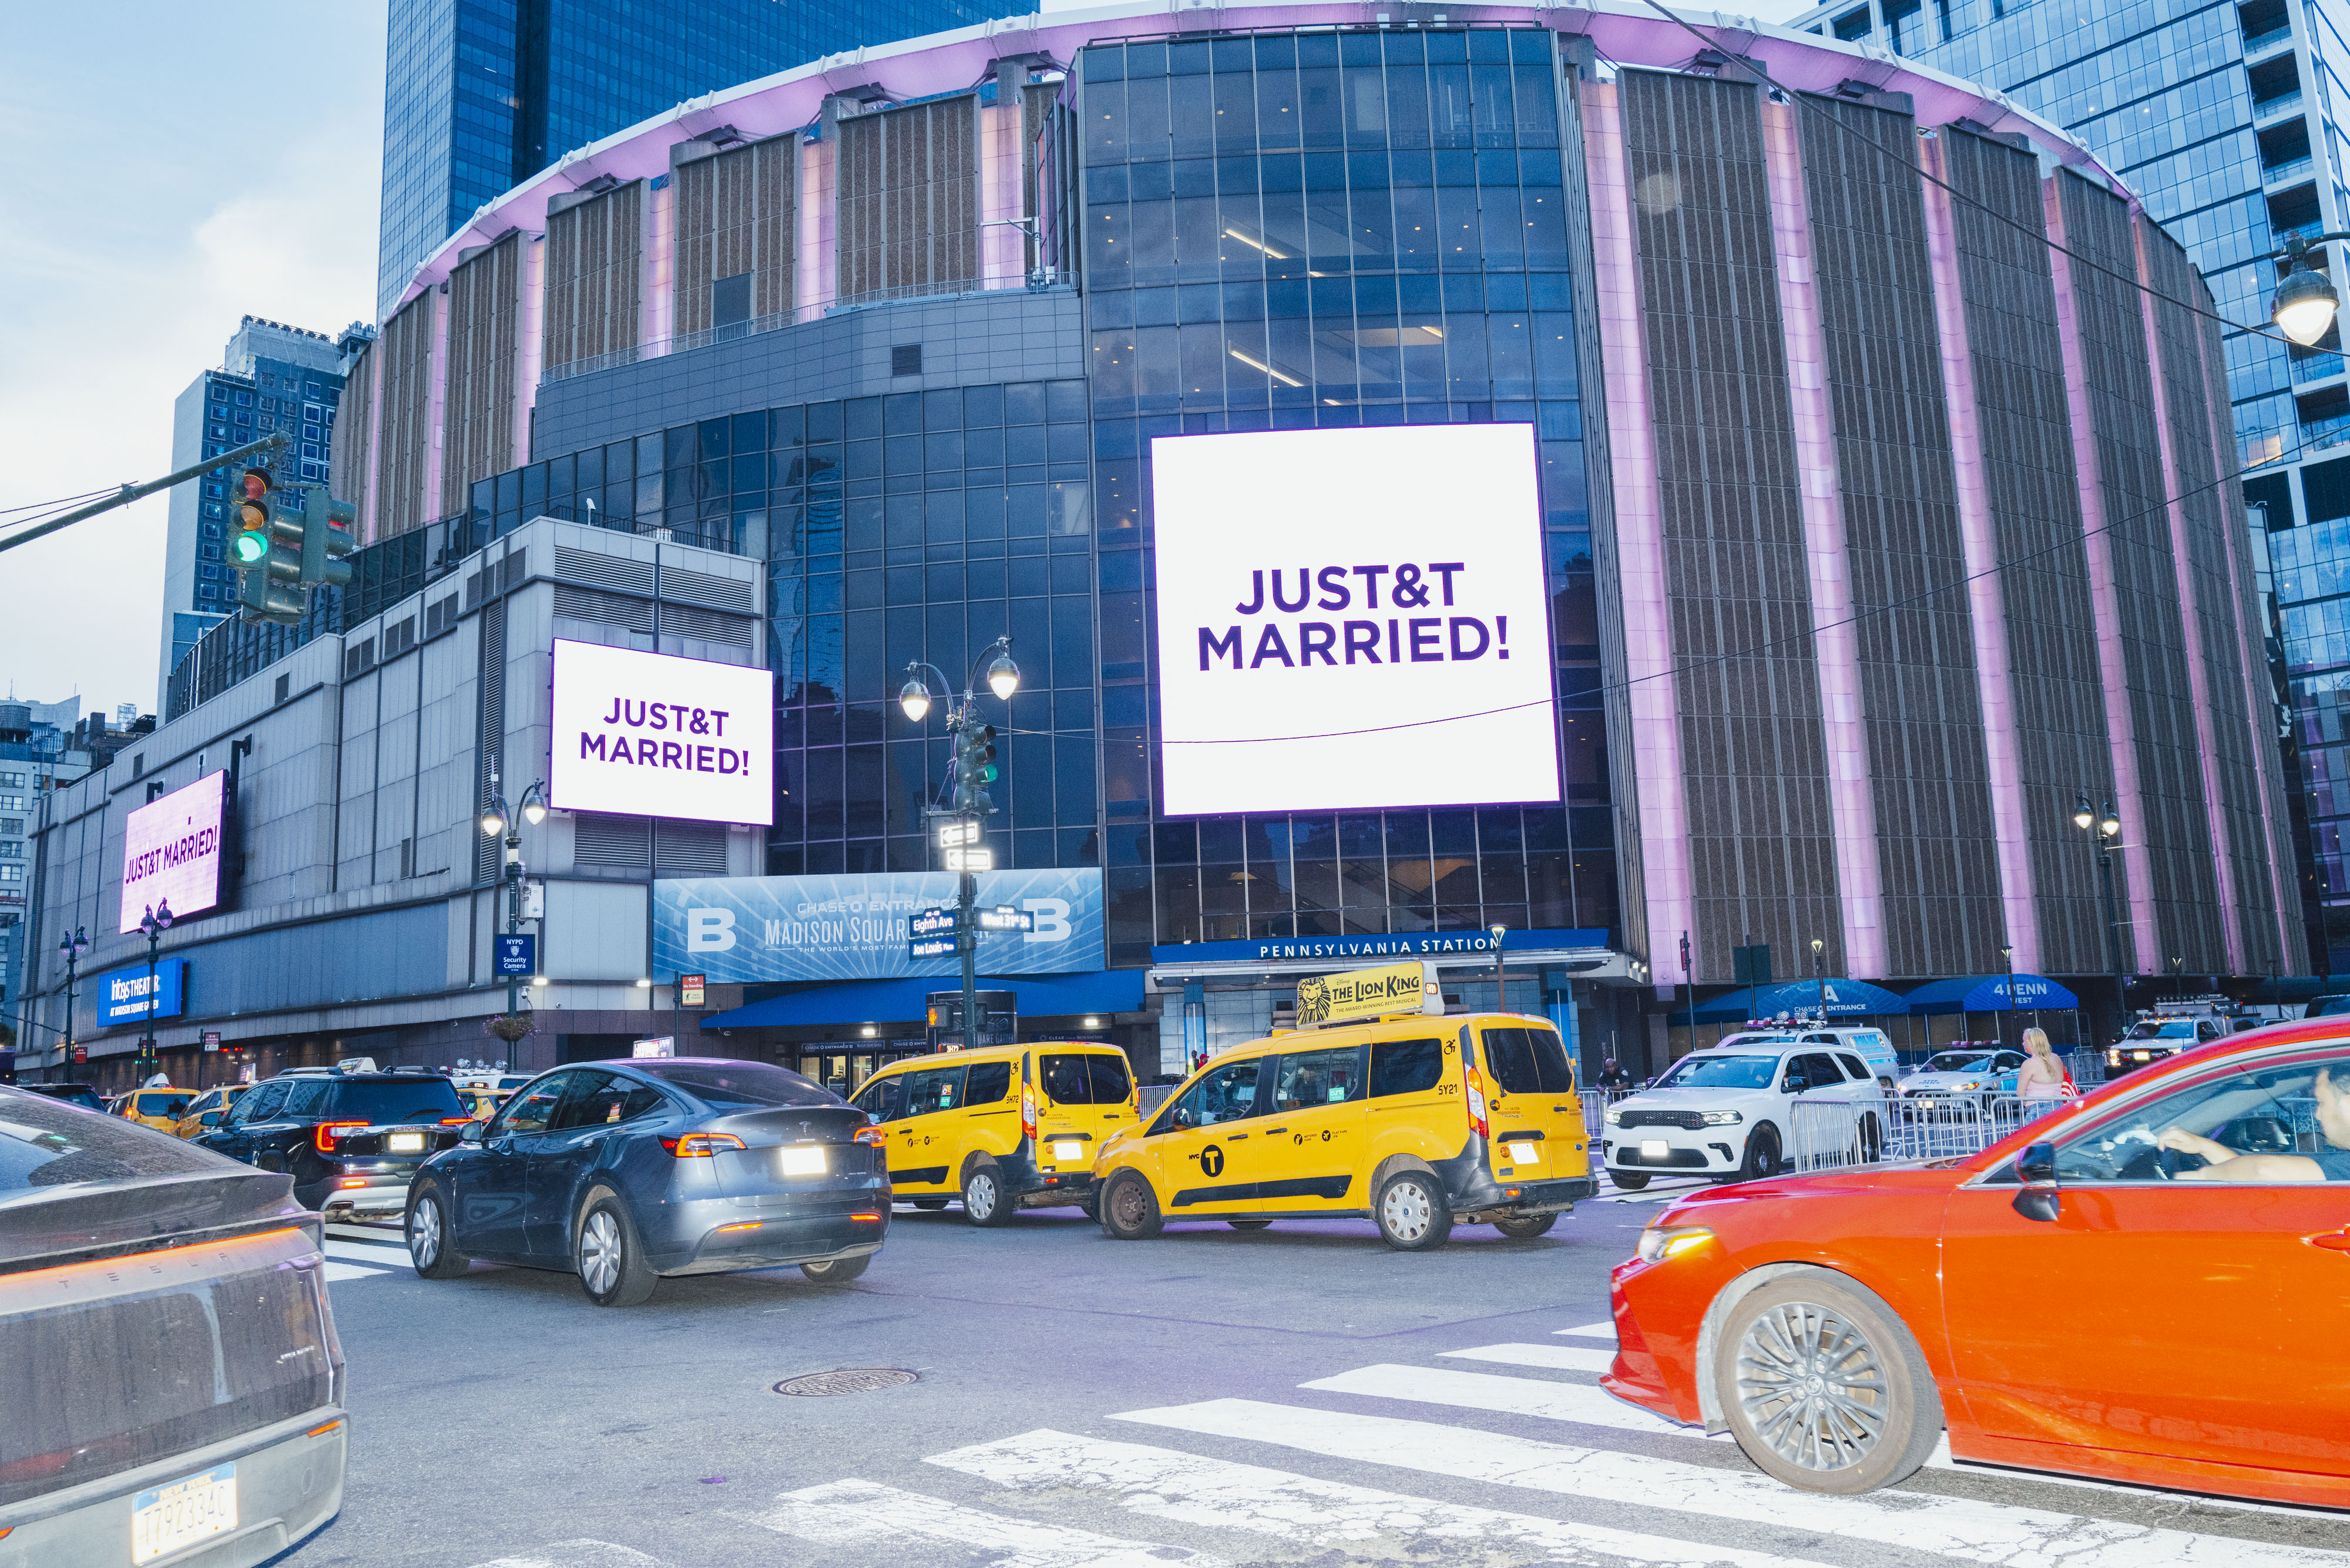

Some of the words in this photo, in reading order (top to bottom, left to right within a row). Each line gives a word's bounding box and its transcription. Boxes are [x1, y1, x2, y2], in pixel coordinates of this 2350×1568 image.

[1235, 562, 1465, 615] JUST&T
[1198, 616, 1509, 671] MARRIED!
[603, 697, 729, 737] JUST&T
[580, 732, 748, 776] MARRIED!
[126, 848, 161, 884] JUST&T
[163, 825, 217, 870] MARRIED!
[797, 902, 847, 914] CHASE
[870, 899, 959, 912] ENTRANCE
[914, 918, 937, 933] Eighth
[938, 916, 954, 928] Ave
[1020, 915, 1030, 928] St
[1023, 898, 1072, 942] B
[688, 908, 737, 952] B
[766, 918, 845, 945] MADISON
[913, 944, 924, 955] Joe
[925, 942, 942, 953] Louis
[1261, 941, 1411, 958] PENNSYLVANIA
[1422, 938, 1499, 952] STATION
[130, 975, 160, 997] THEATR
[1332, 986, 1352, 1000] THE
[1355, 981, 1384, 1002] LION
[1386, 975, 1419, 998] KING
[1426, 983, 1438, 994] 5Y21
[1820, 985, 1839, 1002] A
[1994, 983, 2005, 995] 4
[144, 999, 159, 1011] GAEN
[1345, 1002, 1384, 1012] AWARD-WINNING
[978, 1034, 993, 1044] UARE
[1439, 1084, 1457, 1095] 5Y21
[1006, 1095, 1019, 1104] 3H72
[1205, 1150, 1218, 1173] T
